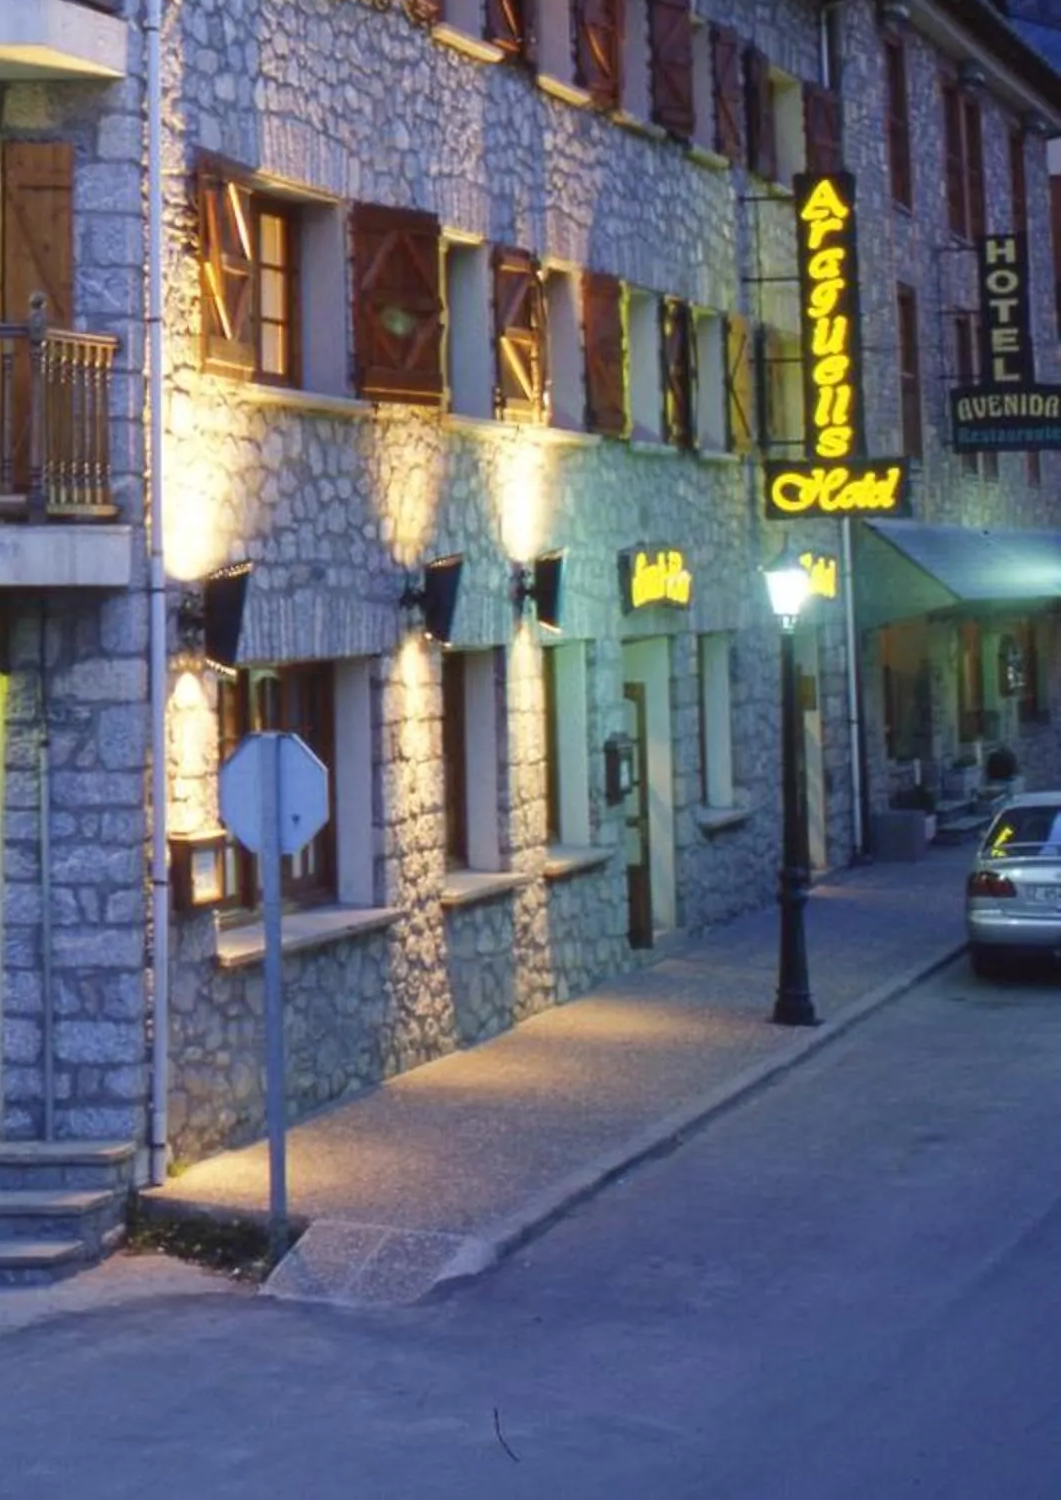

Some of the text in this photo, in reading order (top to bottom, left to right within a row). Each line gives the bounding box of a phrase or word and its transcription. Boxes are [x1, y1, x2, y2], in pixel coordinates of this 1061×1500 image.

[985, 237, 1022, 382] HOTEL
[957, 393, 1060, 422] AVENIDA
[772, 467, 900, 511] Hotel
